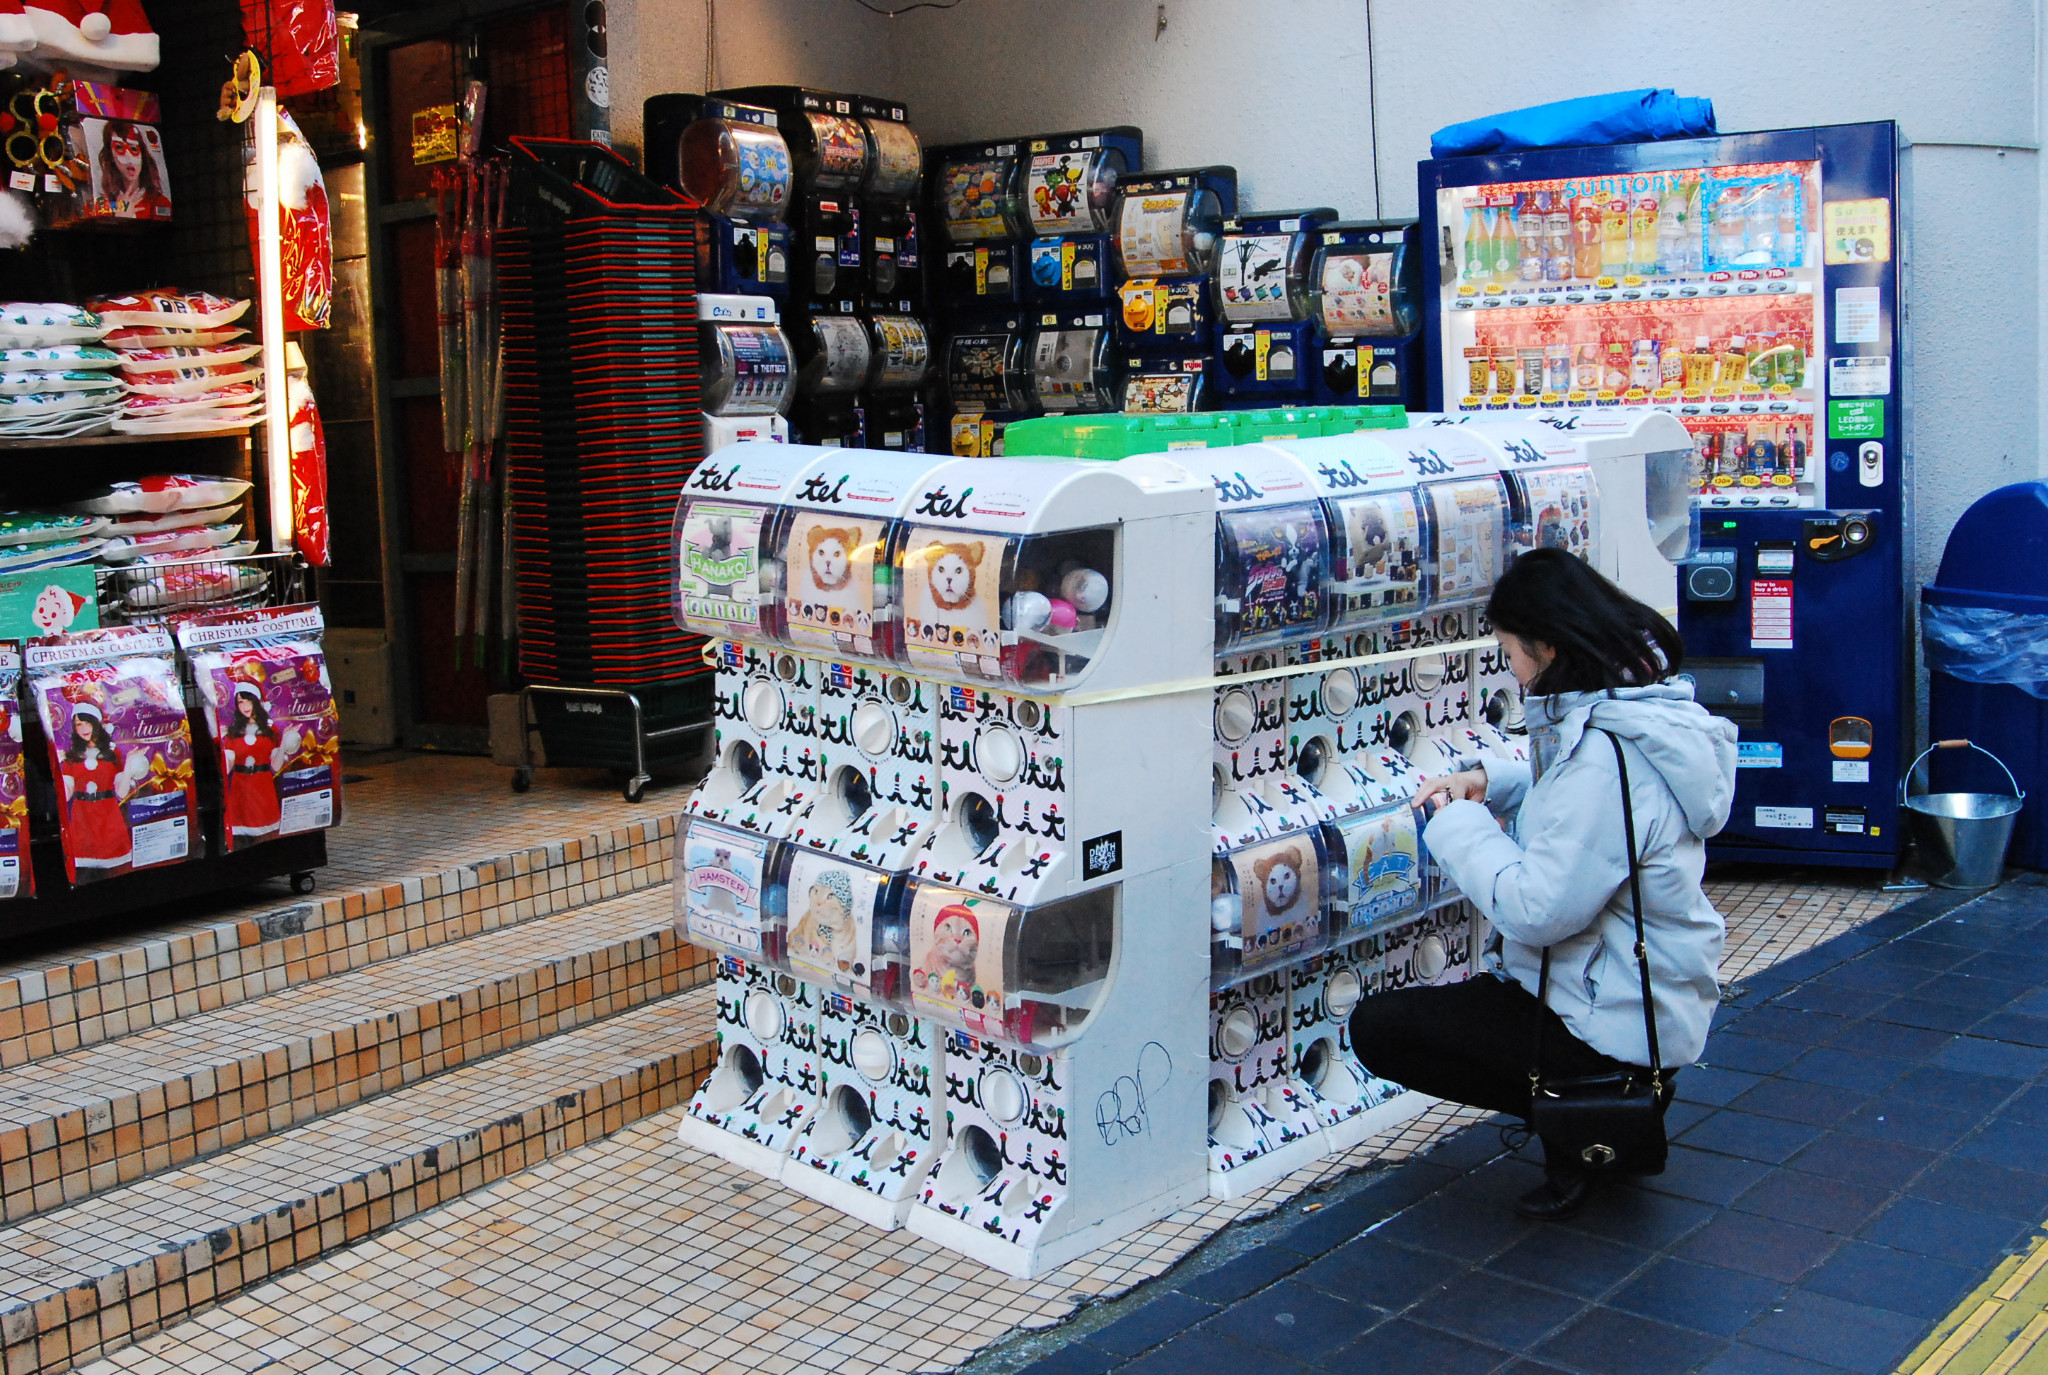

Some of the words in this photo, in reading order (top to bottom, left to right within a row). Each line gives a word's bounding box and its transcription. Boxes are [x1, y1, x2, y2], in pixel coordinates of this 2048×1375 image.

[1171, 286, 1189, 294] ¥300
[1529, 360, 1541, 393] BLACK
[1409, 449, 1454, 475] tel
[1503, 439, 1546, 464] tel
[690, 462, 741, 492] tel
[796, 472, 850, 504] tel
[1212, 472, 1264, 502] tel
[1318, 460, 1368, 489] tel
[915, 485, 974, 519] tel
[693, 557, 745, 577] HANAKO
[190, 626, 258, 642] CHRISTMAS
[263, 615, 317, 632] COSTUME
[32, 646, 105, 664] CHRISTMAS
[699, 873, 745, 893] HAMSTER
